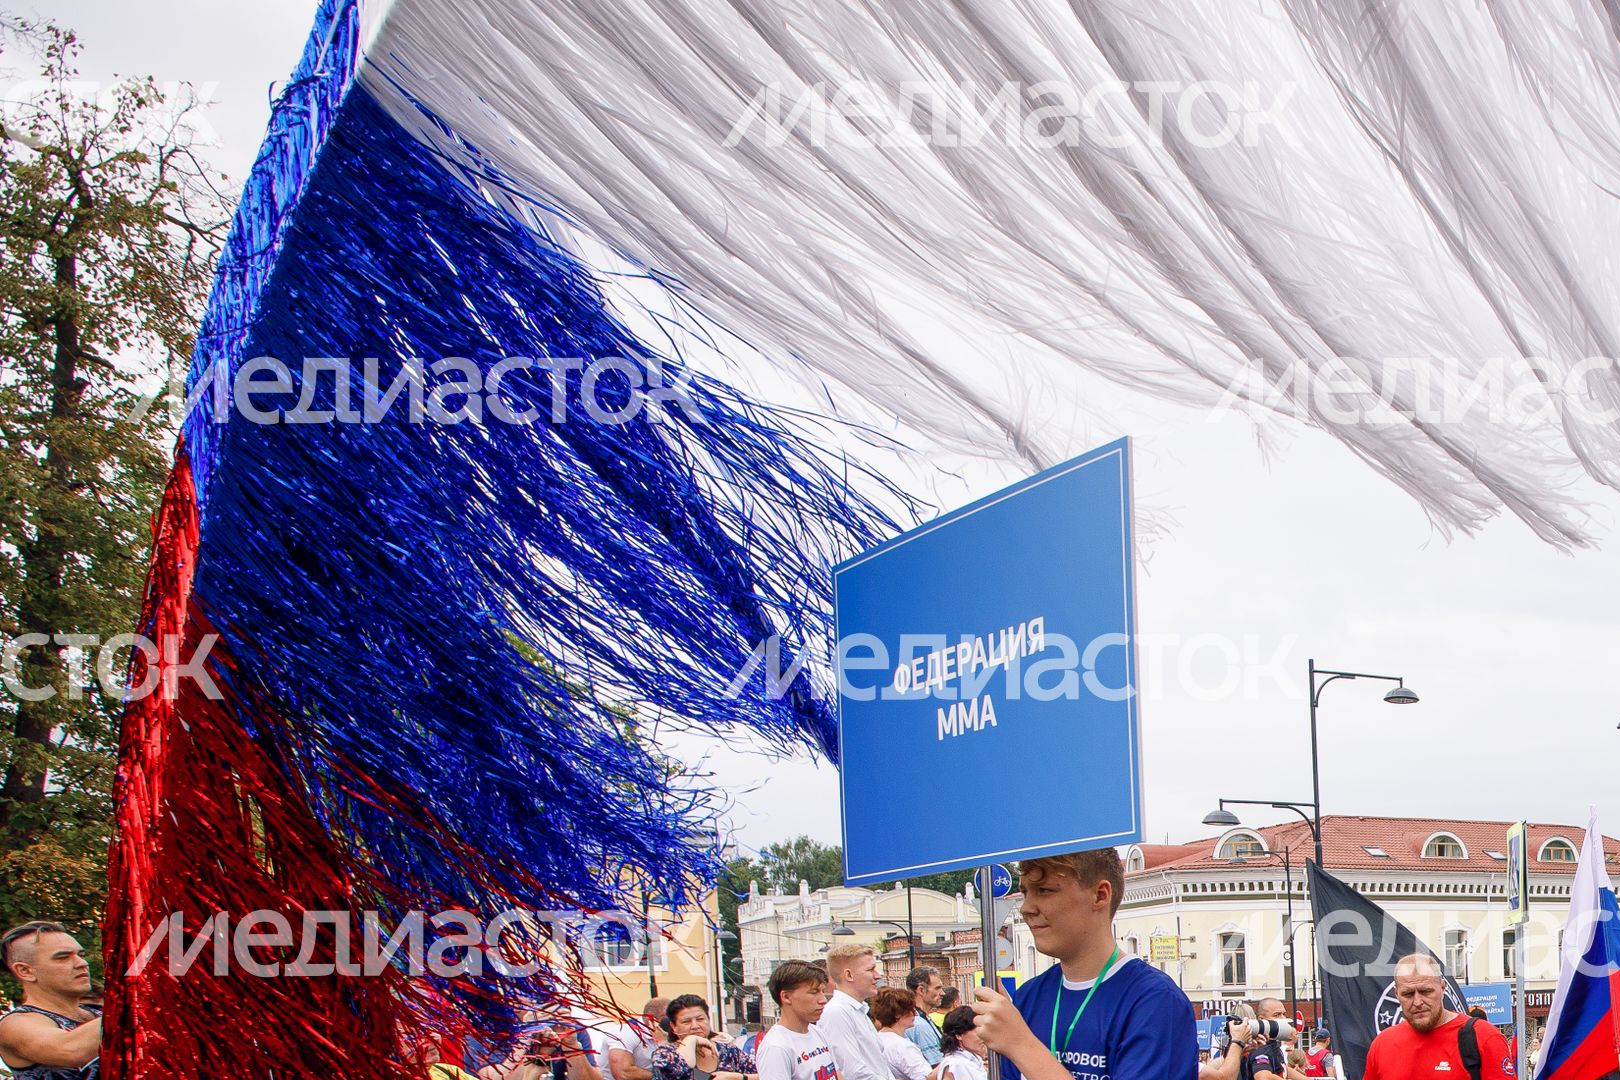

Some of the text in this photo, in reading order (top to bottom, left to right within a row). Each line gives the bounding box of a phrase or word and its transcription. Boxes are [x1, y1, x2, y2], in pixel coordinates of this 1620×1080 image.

[893, 616, 1046, 696] ФЕДЕРАЦИЯ
[936, 692, 998, 741] ММА
[1466, 994, 1497, 1002] ФЕДЕРАЦИЯ
[1055, 1051, 1106, 1068] ДОРОВОЕ
